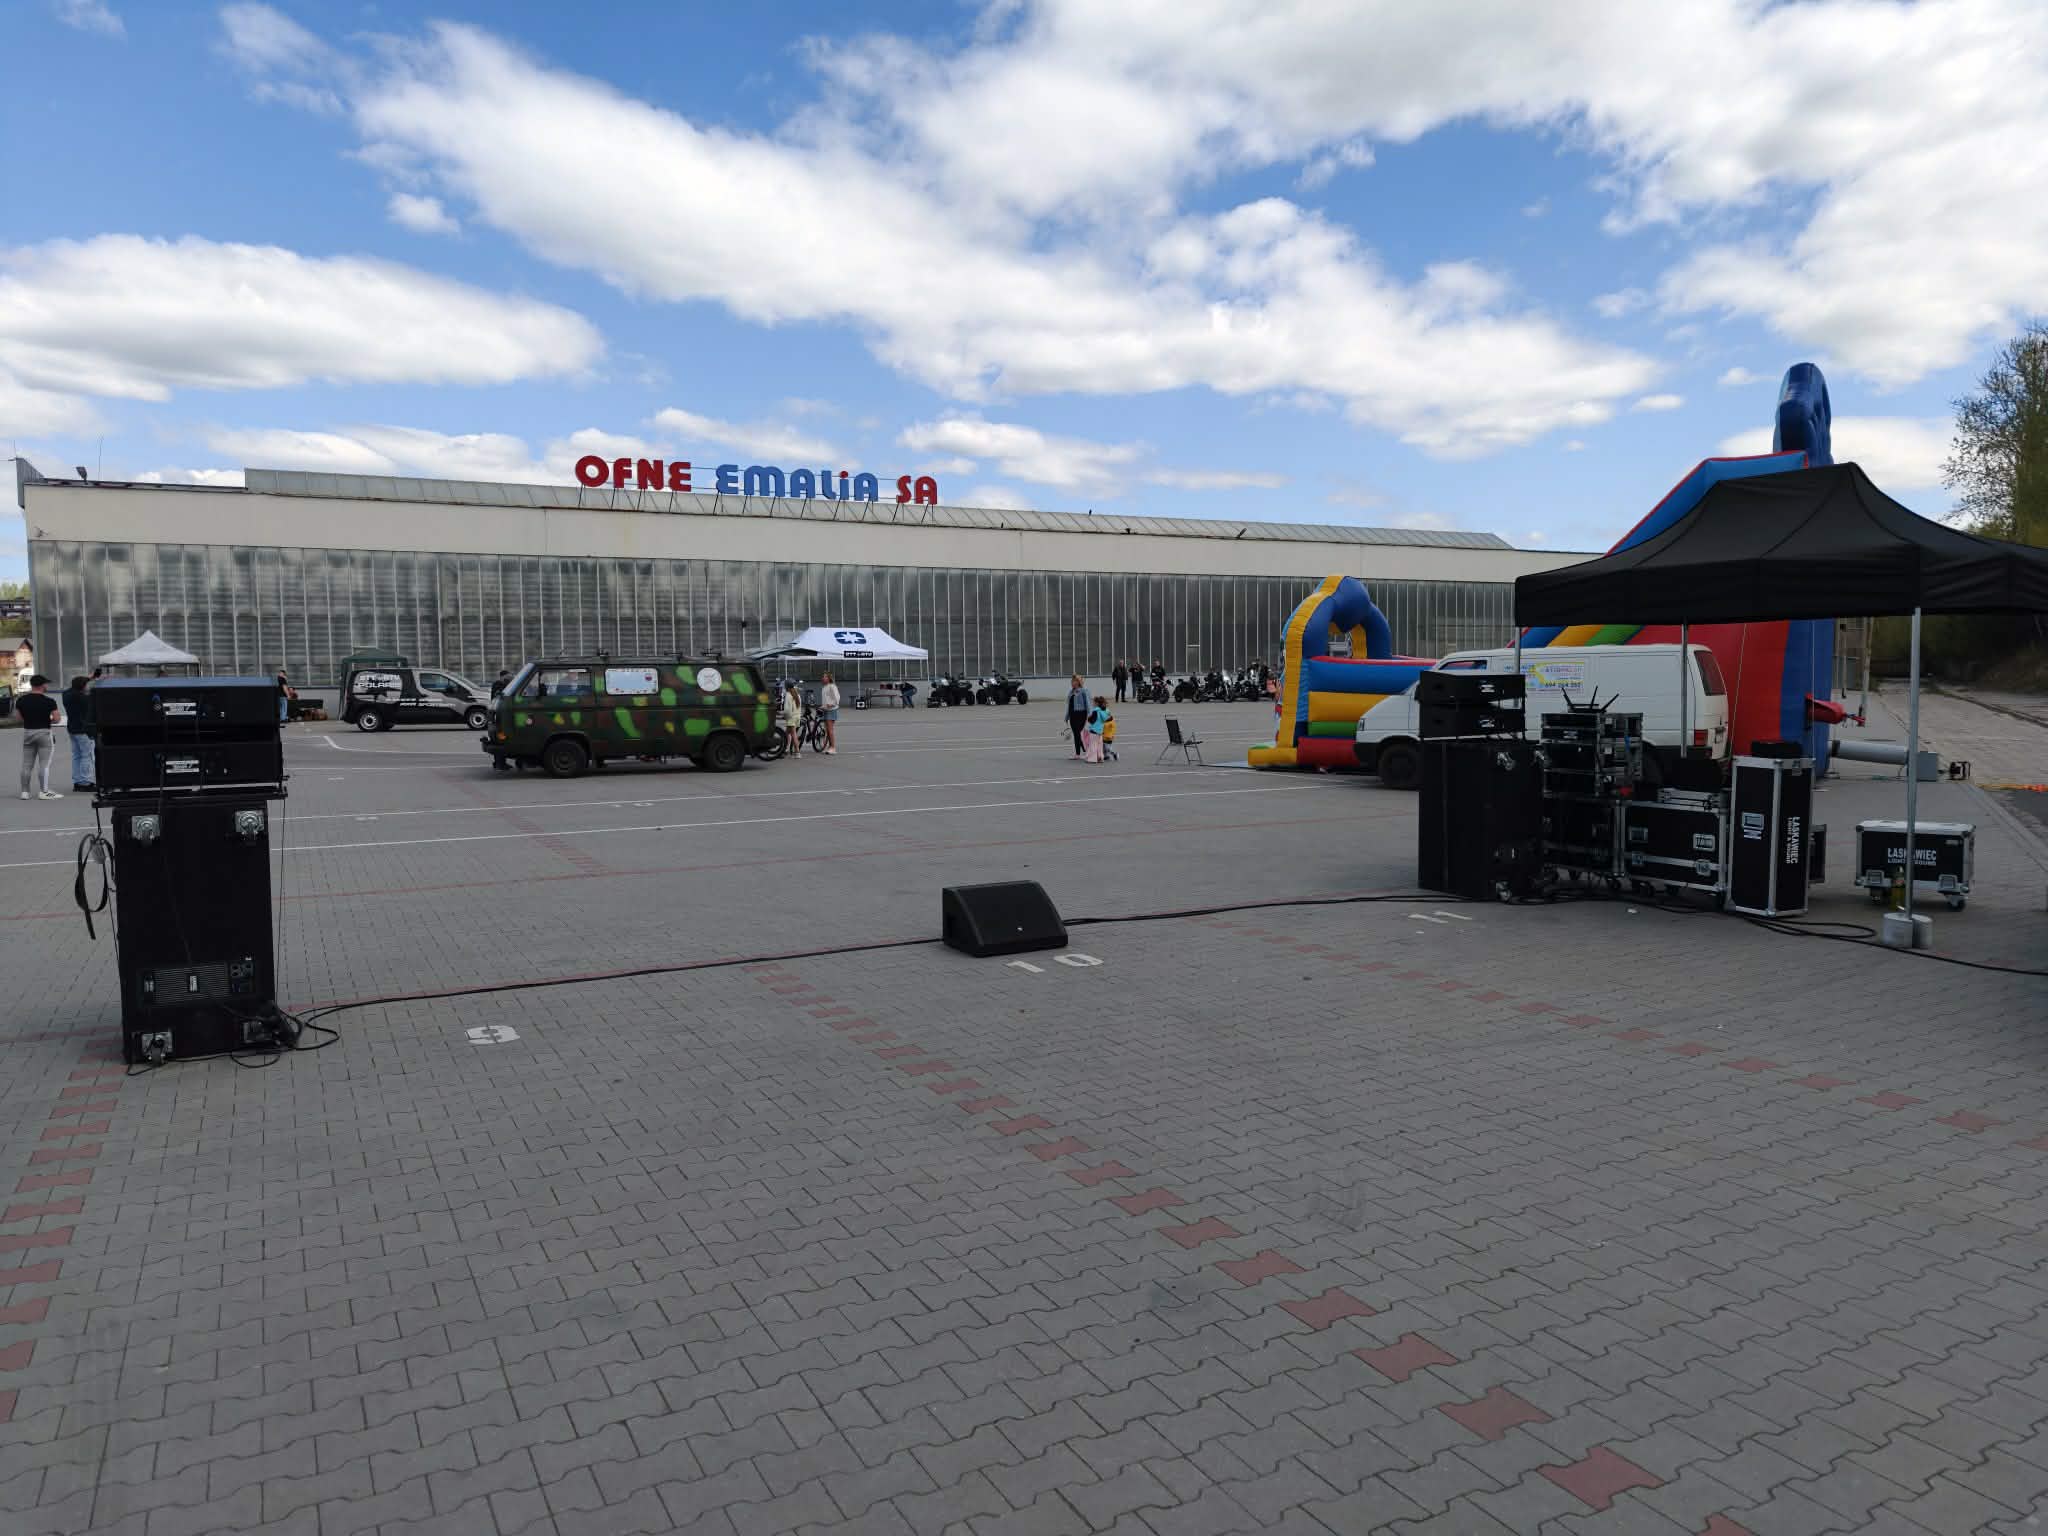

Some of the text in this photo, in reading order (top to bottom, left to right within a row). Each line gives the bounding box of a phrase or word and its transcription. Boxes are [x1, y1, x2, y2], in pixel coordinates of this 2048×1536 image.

[575, 455, 691, 492] OFNE
[896, 475, 938, 505] SA
[1887, 847, 1937, 860] ŁASWIEC
[1006, 953, 1105, 973] 10
